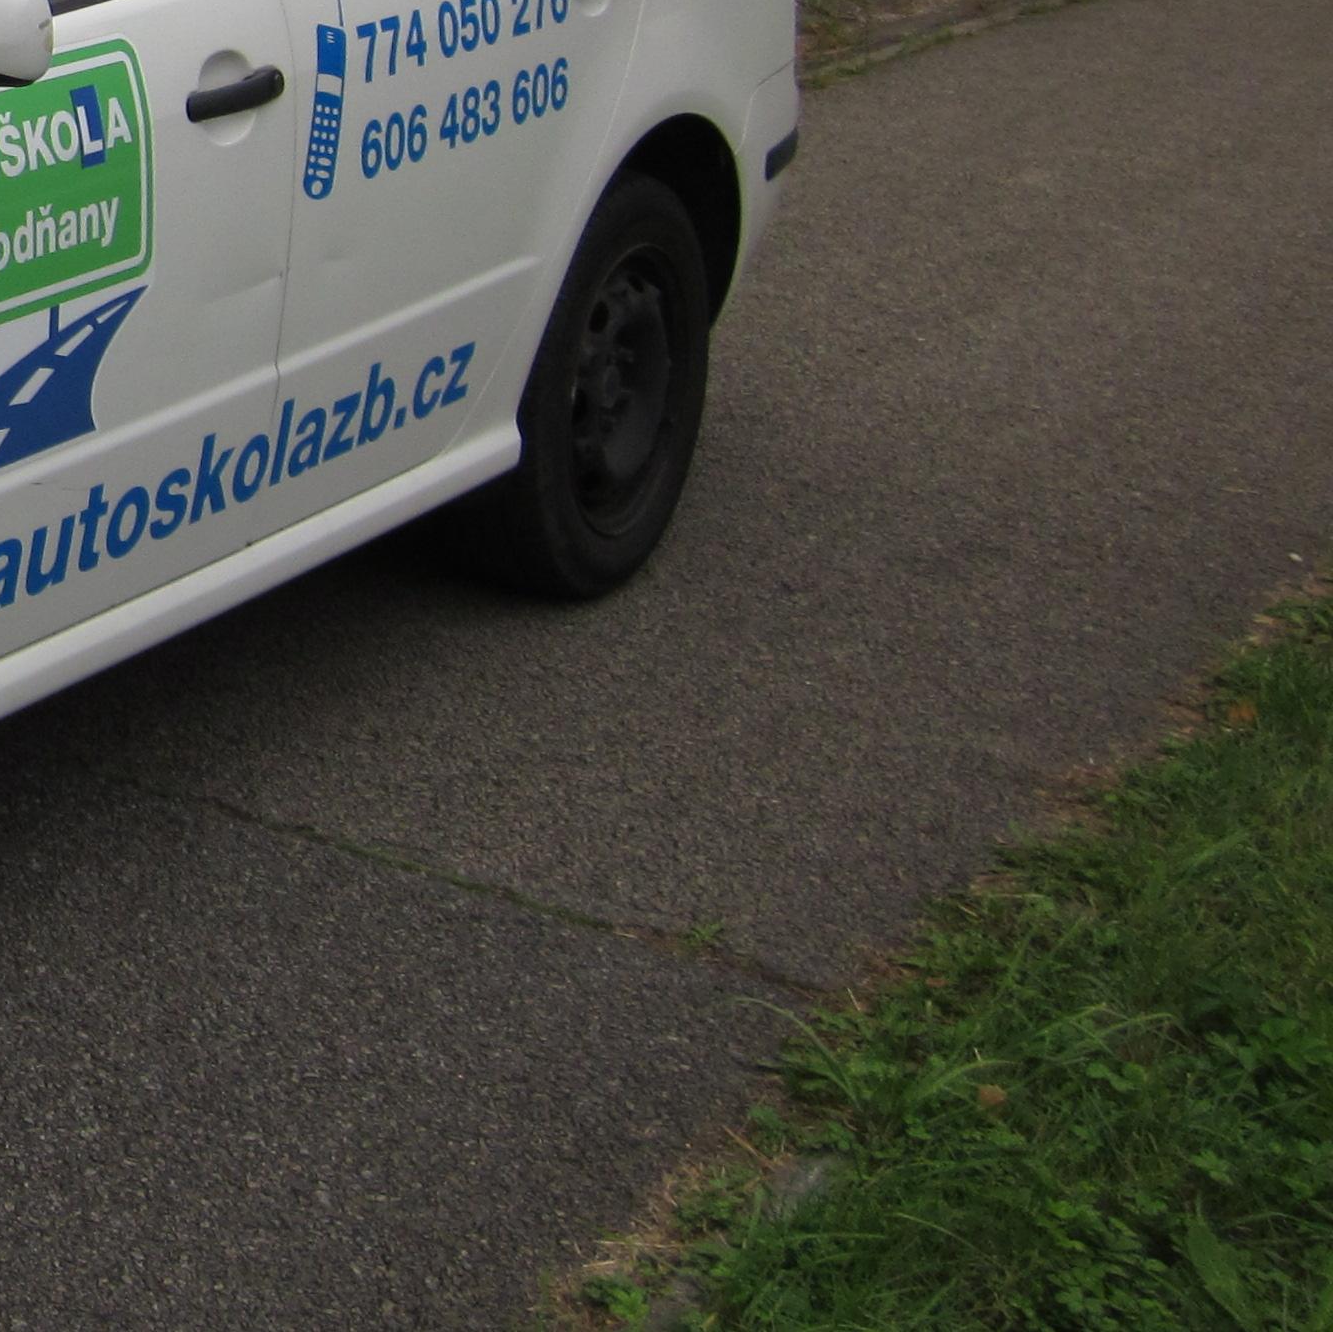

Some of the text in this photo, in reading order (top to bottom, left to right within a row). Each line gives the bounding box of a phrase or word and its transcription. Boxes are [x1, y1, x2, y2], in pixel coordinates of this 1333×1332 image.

[356, 8, 427, 83] 774
[361, 56, 568, 180] 606 483 606
